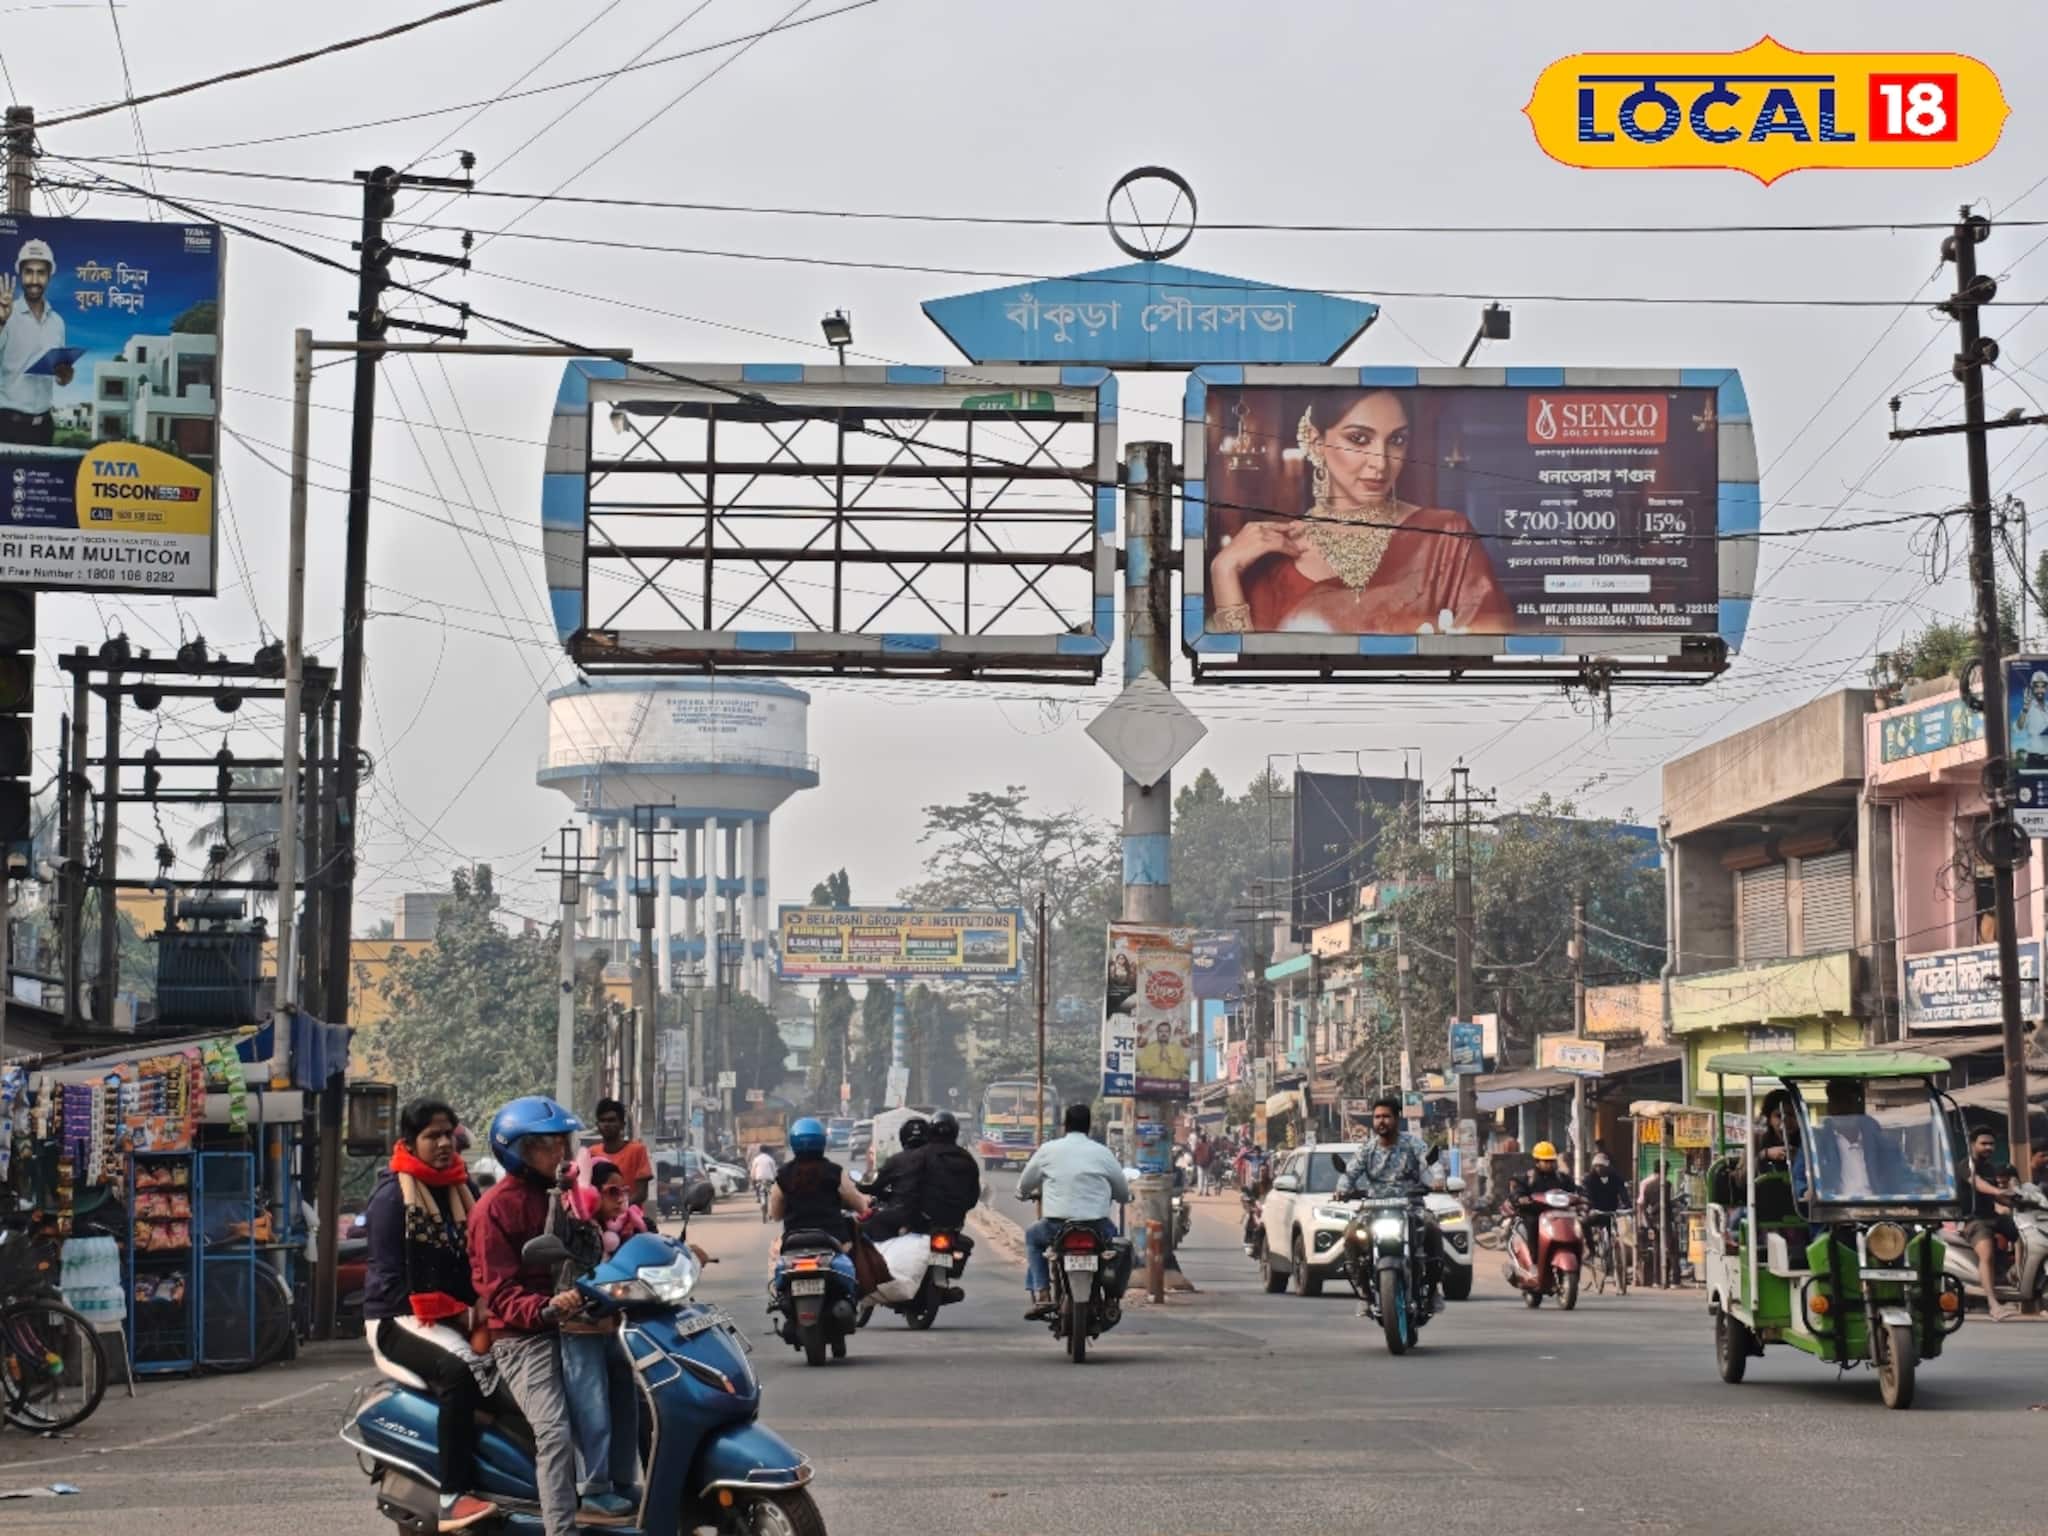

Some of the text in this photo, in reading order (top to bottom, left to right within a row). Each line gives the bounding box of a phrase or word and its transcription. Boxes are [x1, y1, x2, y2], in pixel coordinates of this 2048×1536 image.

[1005, 291, 1297, 343] বাঁকুড়া পৌরসভা
[1561, 403, 1659, 429] SENCO
[92, 461, 140, 478] TATA
[1538, 468, 1611, 484] ধনতেরাস
[91, 483, 158, 500] TISCON
[1645, 512, 1687, 533] 15%
[0, 543, 190, 565] RI RAM MULTICOM
[8, 566, 31, 576] Free
[33, 568, 74, 579] Number
[87, 568, 116, 580] 1800
[806, 915, 1010, 928] BELARANI GROUP OF INSTITUTIONS
